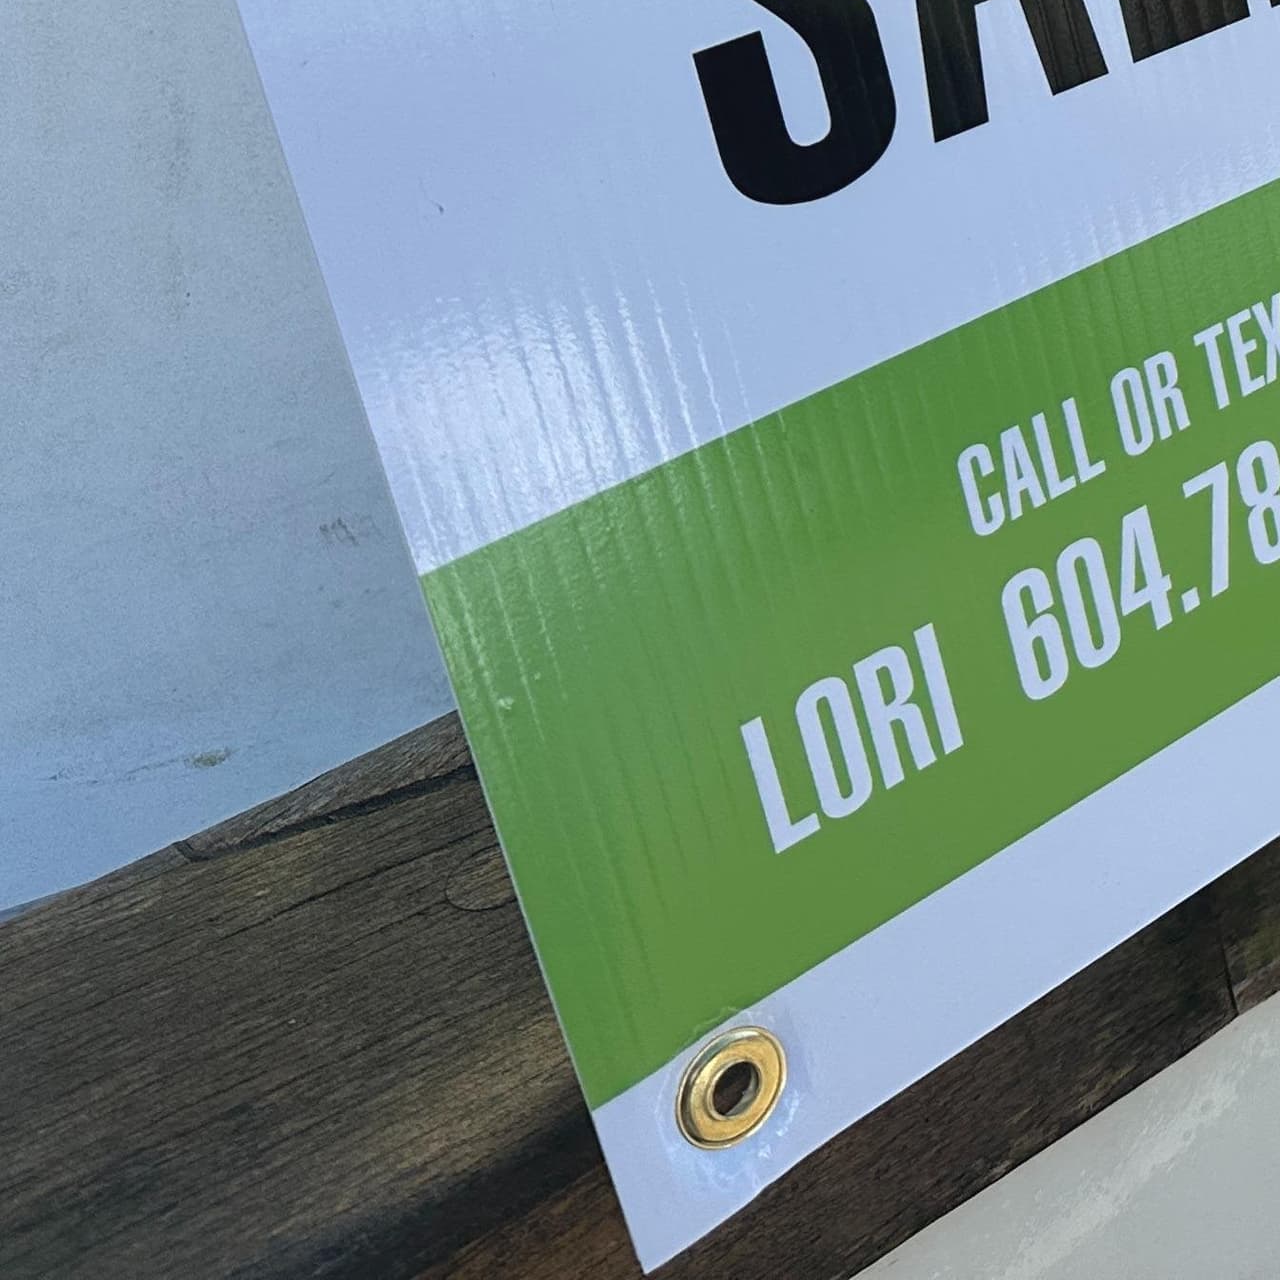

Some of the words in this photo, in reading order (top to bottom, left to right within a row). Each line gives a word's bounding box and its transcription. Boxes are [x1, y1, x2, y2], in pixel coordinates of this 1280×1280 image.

[957, 397, 1106, 536] CALL
[1111, 350, 1191, 456] OR
[740, 623, 964, 854] LORI
